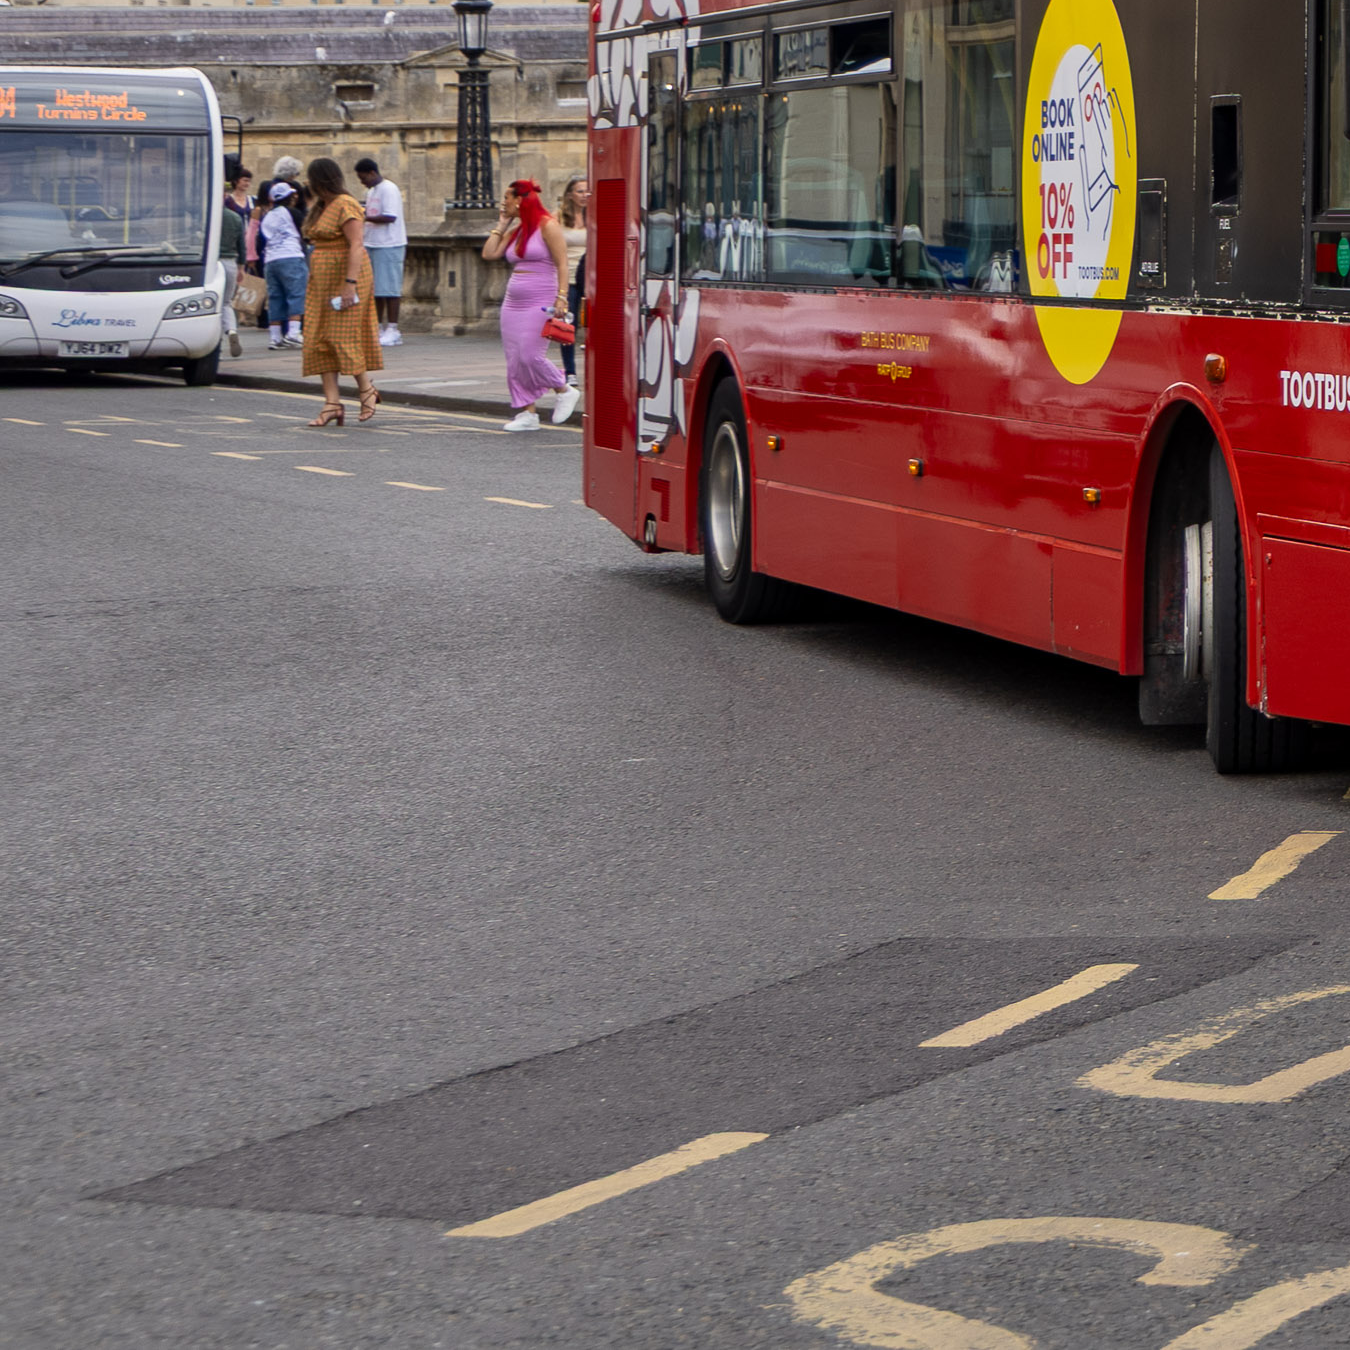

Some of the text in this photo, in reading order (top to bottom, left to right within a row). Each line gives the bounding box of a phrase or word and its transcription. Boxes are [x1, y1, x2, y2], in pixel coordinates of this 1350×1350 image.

[55, 89, 128, 108] Westwood
[101, 106, 147, 121] Circle
[1041, 97, 1075, 129] BOOK
[1032, 131, 1075, 163] ONLINE
[1039, 182, 1075, 230] 10%
[1219, 218, 1231, 230] FUEL
[1037, 232, 1074, 280] OFF
[1078, 266, 1120, 281] TOOTBUS.COM
[51, 309, 137, 328] Libra TRAVEL
[861, 331, 930, 352] BATH BUS COMPANY
